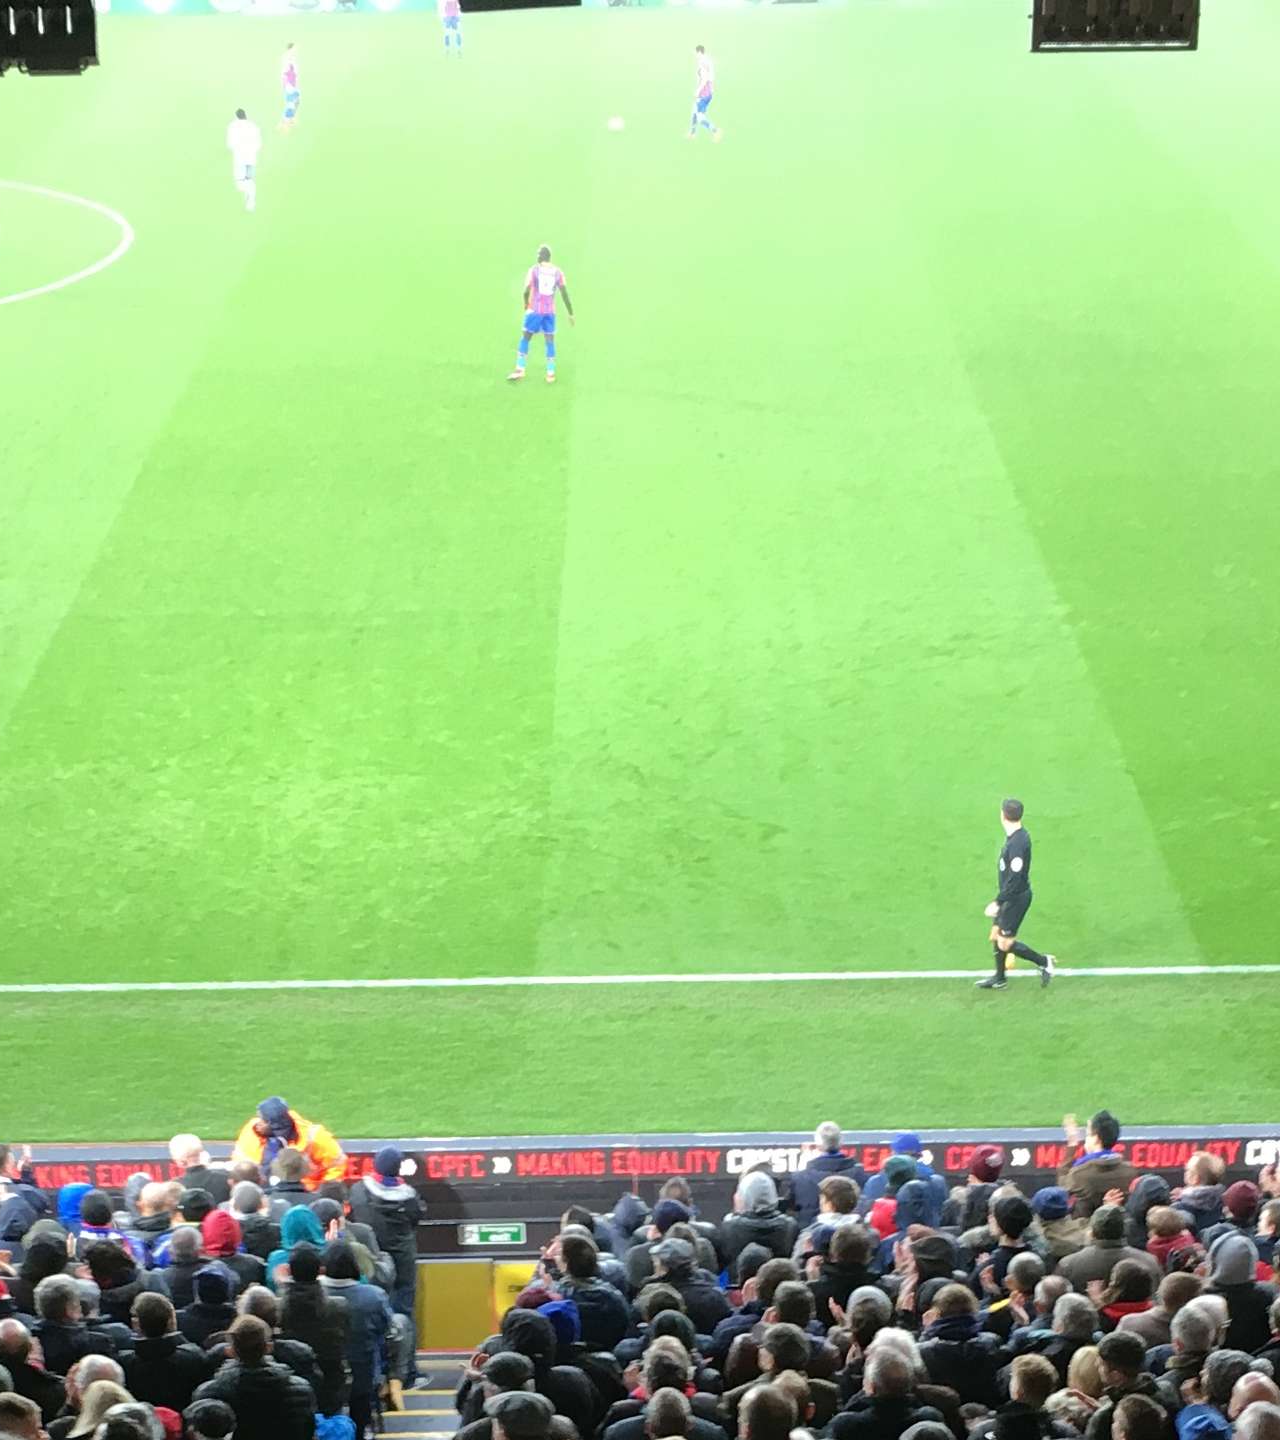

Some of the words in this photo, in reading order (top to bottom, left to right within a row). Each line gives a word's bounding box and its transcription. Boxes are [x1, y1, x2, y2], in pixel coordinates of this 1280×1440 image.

[426, 1155, 486, 1180] CPFC
[516, 1150, 606, 1177] MAKING
[611, 1149, 720, 1176] EQUALITY
[726, 1148, 810, 1174] CRYST
